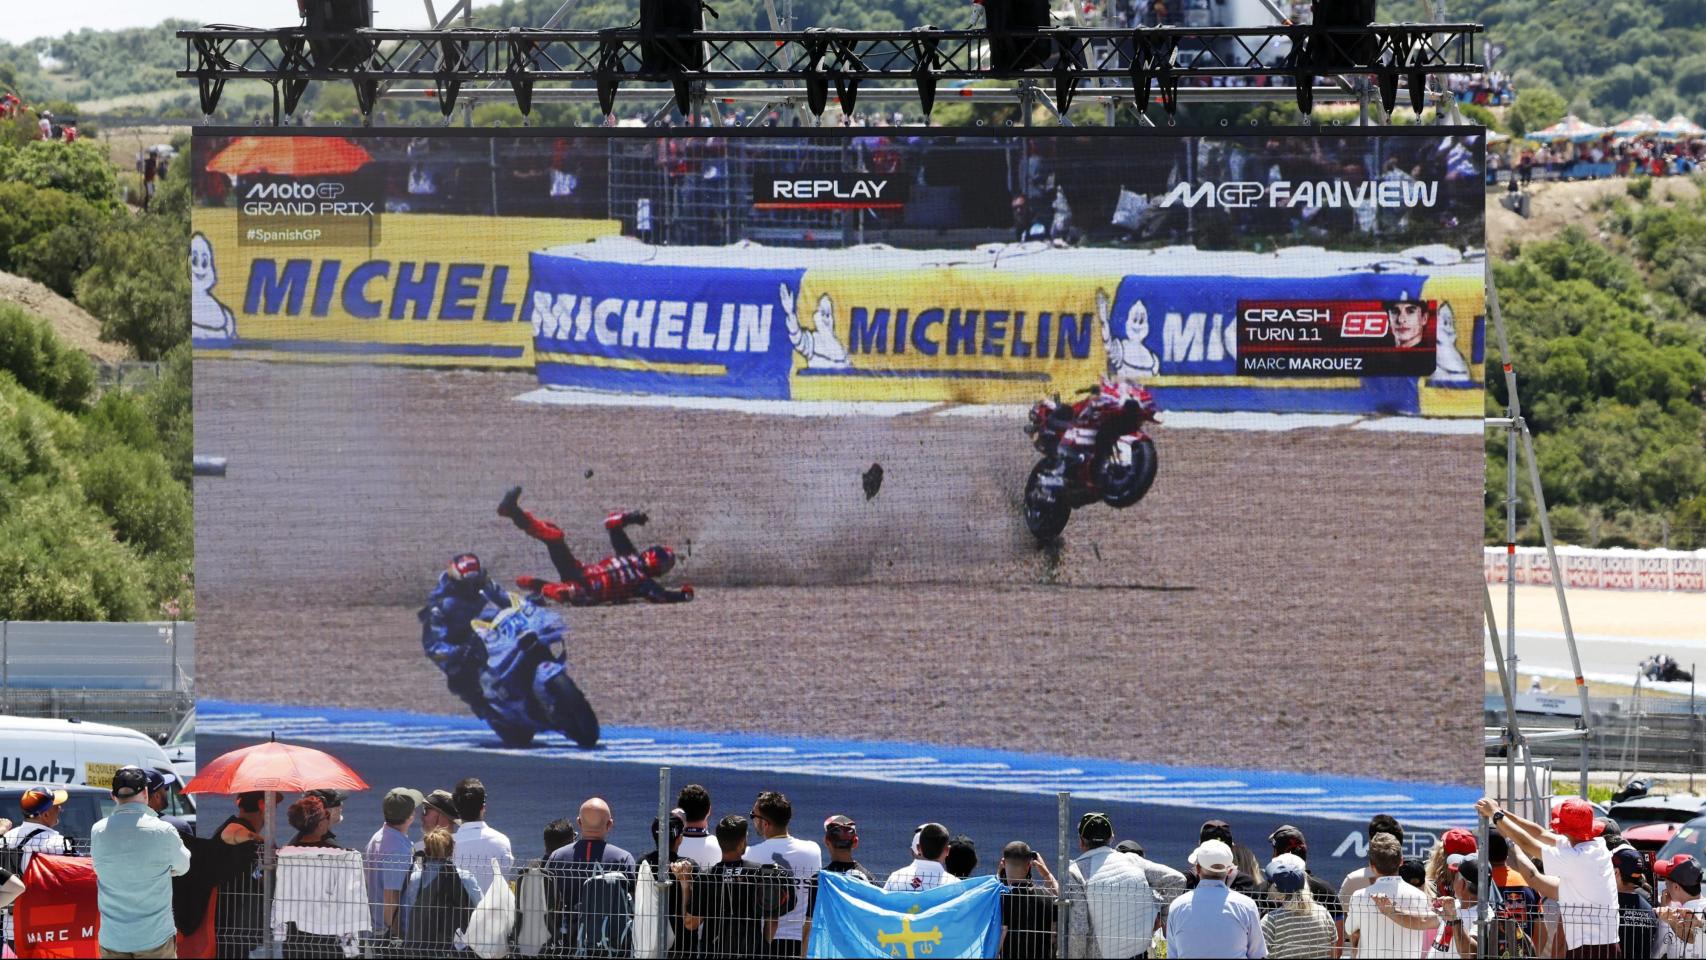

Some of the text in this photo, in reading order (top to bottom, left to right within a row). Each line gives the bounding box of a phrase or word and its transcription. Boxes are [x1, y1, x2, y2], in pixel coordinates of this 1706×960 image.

[245, 182, 344, 199] MotoGP
[773, 180, 887, 198] REPLAY
[1269, 181, 1438, 208] FANVIEW
[243, 202, 375, 216] GRAND PRIX
[246, 229, 322, 243] #SpanishGP
[531, 290, 774, 352] MICHELIN
[1244, 308, 1331, 323] CRASH
[848, 306, 1095, 360] MICHELIN
[1246, 327, 1323, 341] TURN 11
[1244, 358, 1363, 370] MARC MARQUEZ
[1, 757, 75, 784] Hertz
[27, 929, 69, 943] MARC
